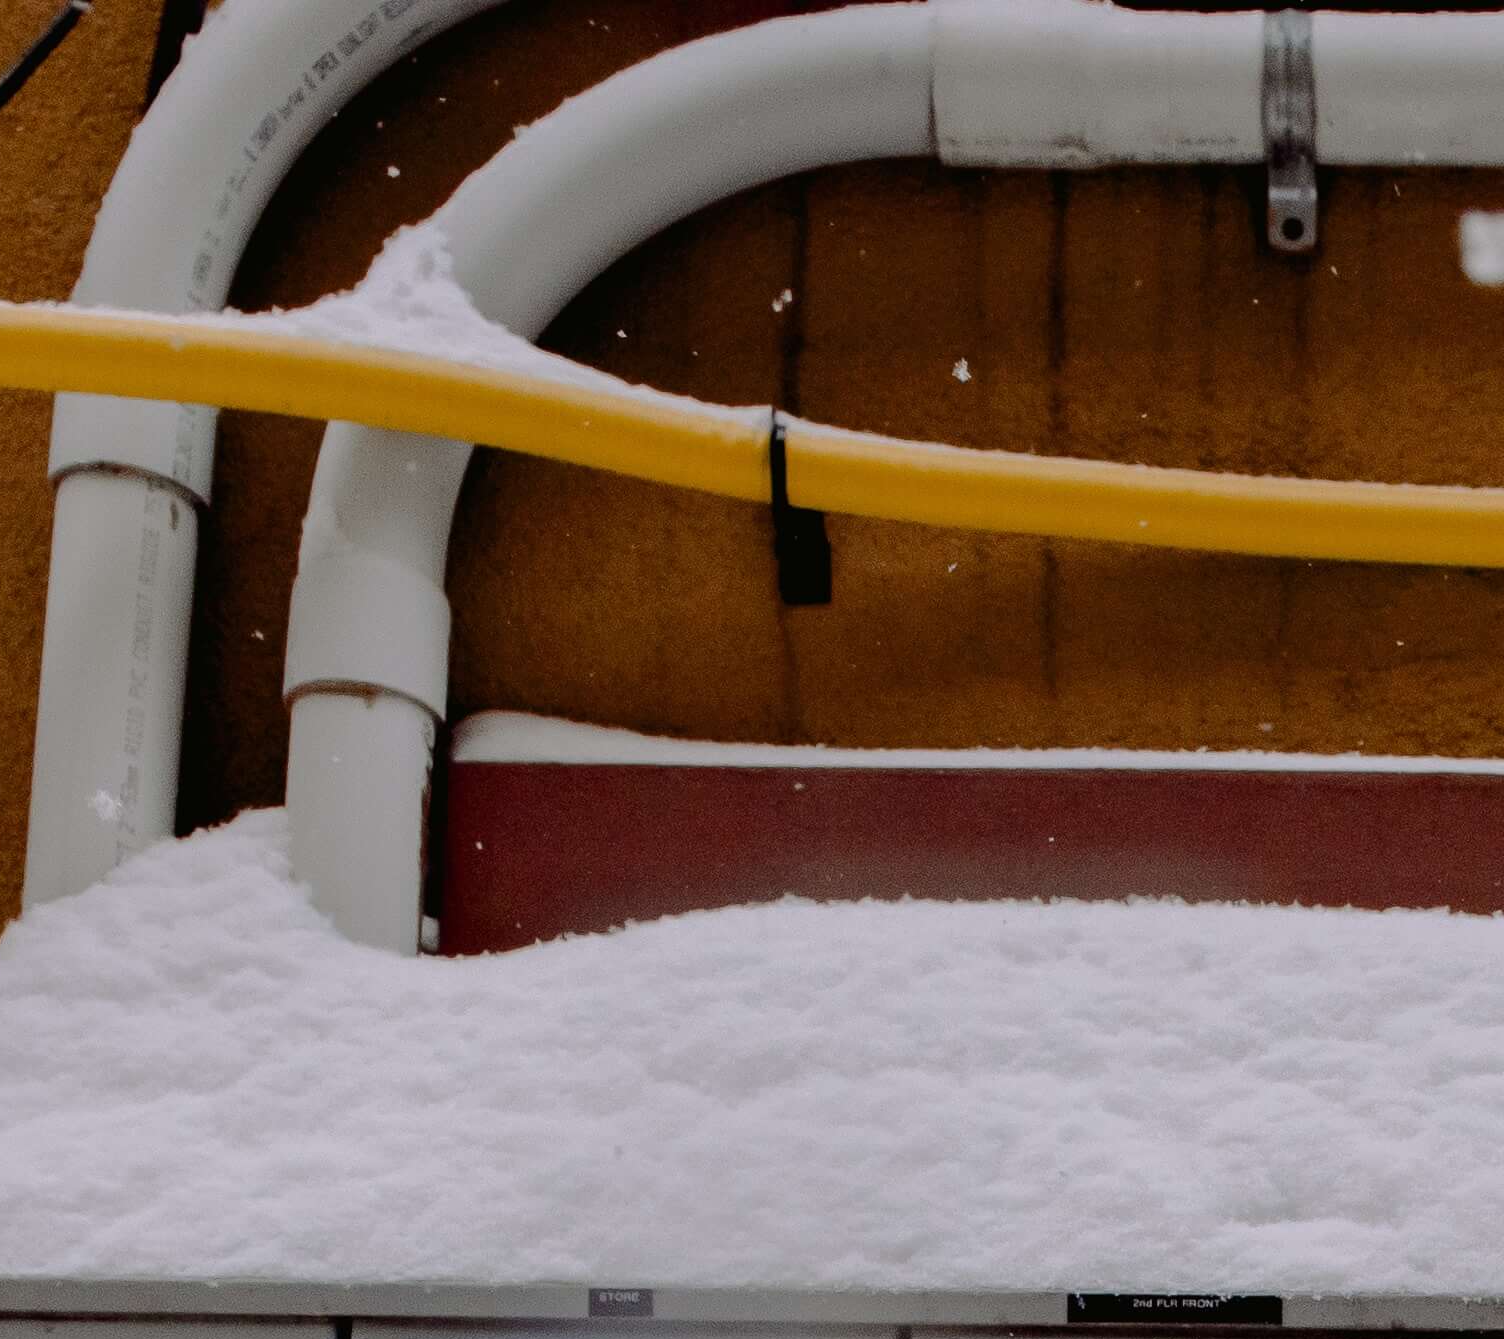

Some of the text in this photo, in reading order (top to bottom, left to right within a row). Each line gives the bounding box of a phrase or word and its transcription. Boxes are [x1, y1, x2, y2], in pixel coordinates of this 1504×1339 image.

[1132, 1299, 1221, 1309] 2nd FLR FRONT
